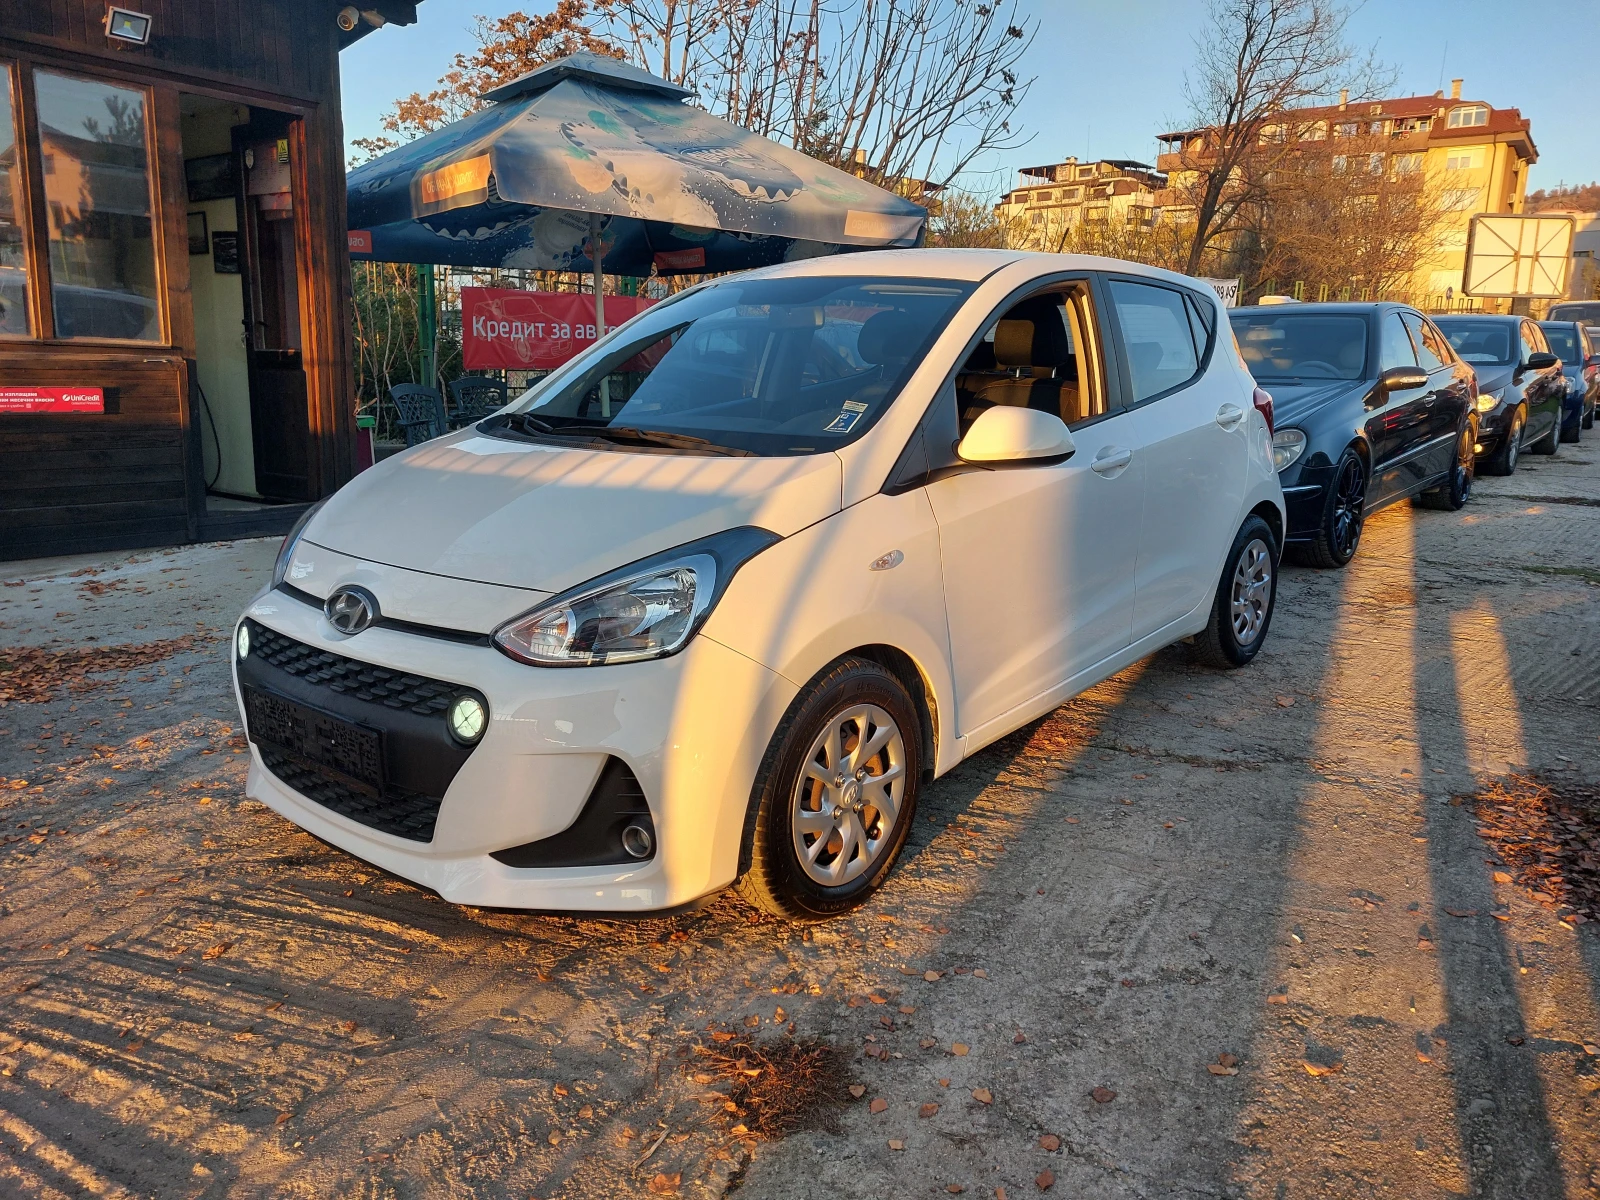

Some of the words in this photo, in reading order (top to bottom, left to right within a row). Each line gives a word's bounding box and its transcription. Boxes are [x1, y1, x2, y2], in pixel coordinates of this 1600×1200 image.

[472, 315, 545, 342] Кредит
[551, 323, 571, 339] за
[70, 394, 100, 402] UniCredit
